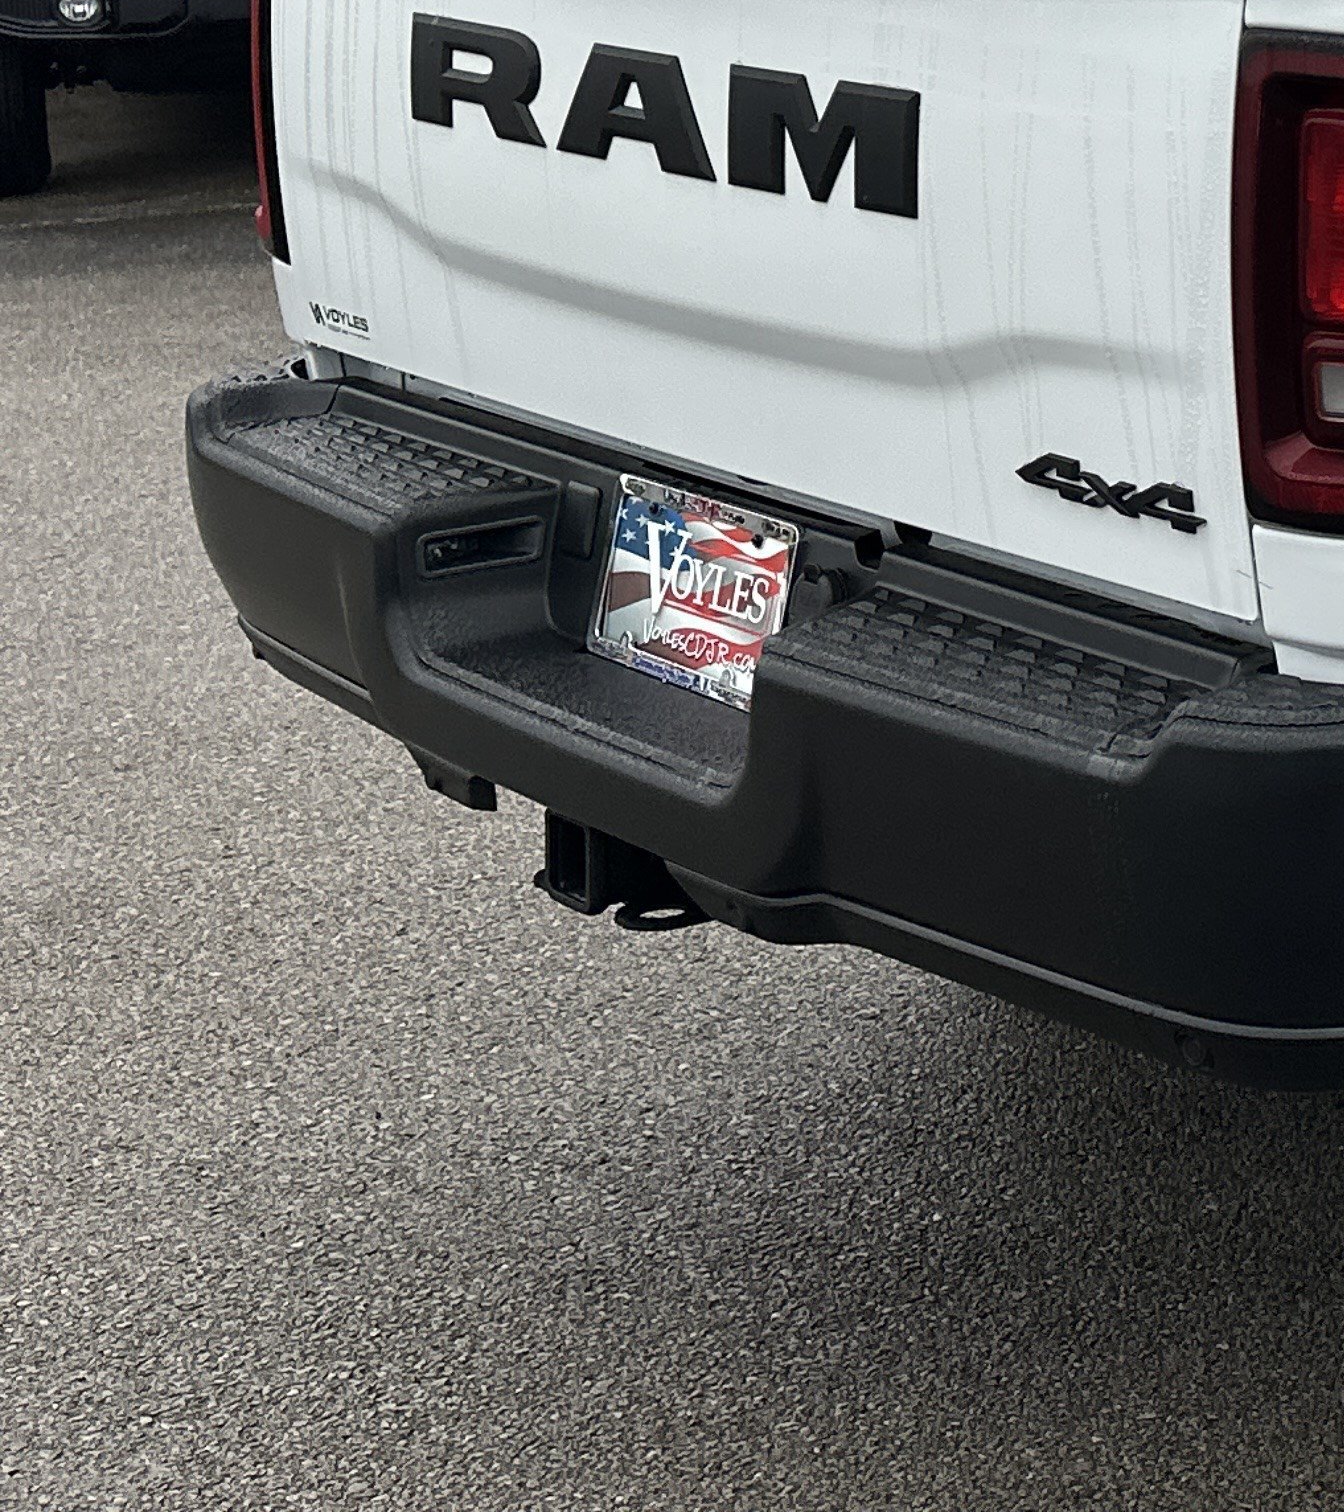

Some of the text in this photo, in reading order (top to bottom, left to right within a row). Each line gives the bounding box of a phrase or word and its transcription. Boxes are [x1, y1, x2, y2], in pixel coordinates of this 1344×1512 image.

[410, 11, 921, 220] RAM
[322, 305, 369, 333] VOYLES
[1015, 452, 1208, 534] 4x4
[647, 520, 769, 624] VOYLES
